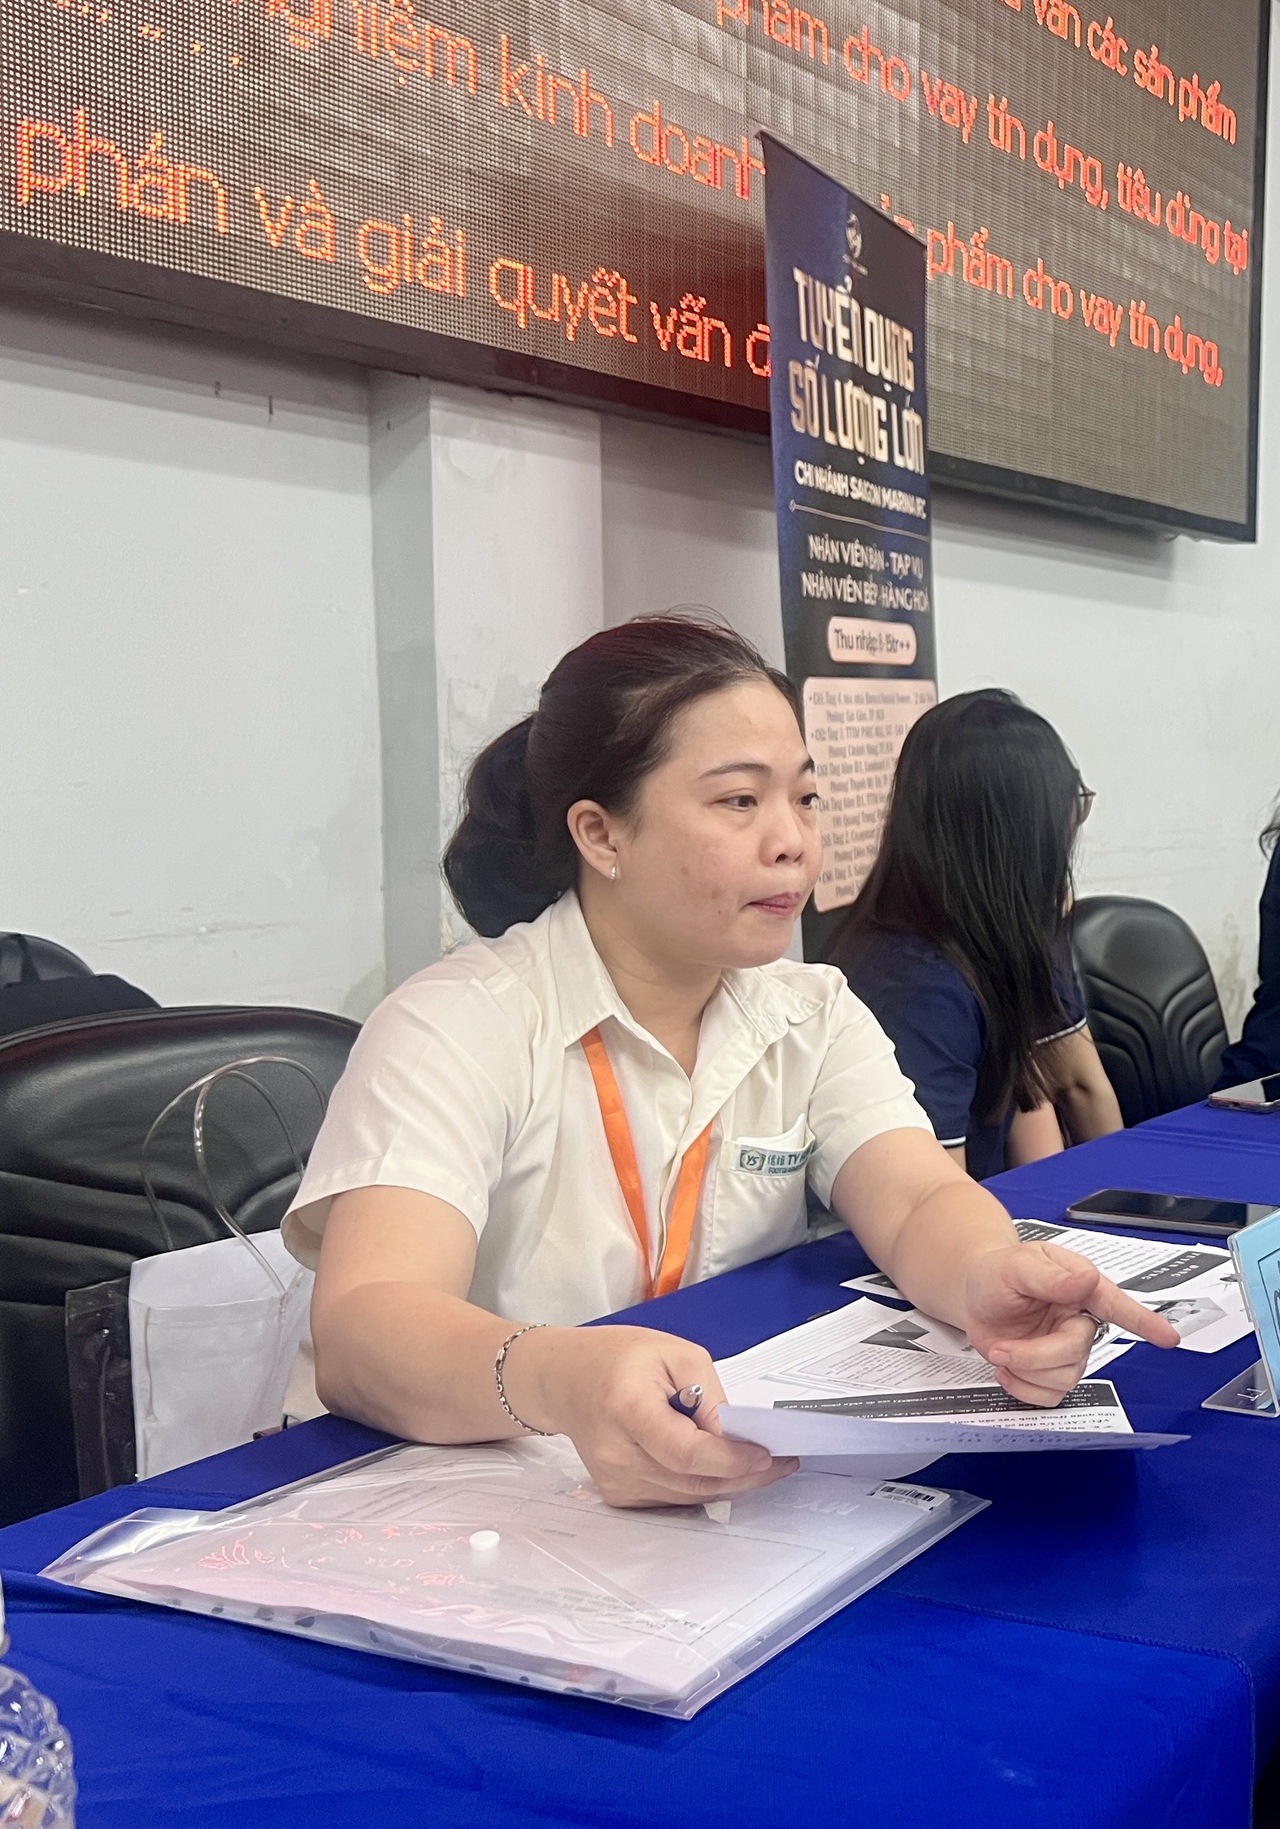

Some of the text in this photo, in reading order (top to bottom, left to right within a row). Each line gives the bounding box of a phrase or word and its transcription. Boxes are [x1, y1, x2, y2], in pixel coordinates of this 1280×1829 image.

[1086, 16, 1129, 77] các
[1133, 44, 1176, 107] sản
[1178, 72, 1238, 145] phẩm
[499, 33, 615, 148] kinh
[925, 219, 1014, 299] phẩm
[1023, 256, 1074, 320] cho
[1079, 288, 1124, 348] vay
[1129, 298, 1170, 354] tín
[842, 24, 912, 102] cho
[920, 68, 978, 144] vay
[986, 92, 1027, 161] tín
[1116, 160, 1162, 227] tiêu
[1165, 189, 1221, 265] dùng
[1223, 219, 1248, 275] tại
[253, 177, 336, 264] và
[356, 212, 468, 299] giải
[488, 265, 639, 343] quyết
[650, 291, 733, 369] vấn
[793, 267, 915, 393] TUYỂN DỤNG
[788, 353, 926, 476] SỐ LƯỢNG LỚN
[834, 628, 854, 650] Thu
